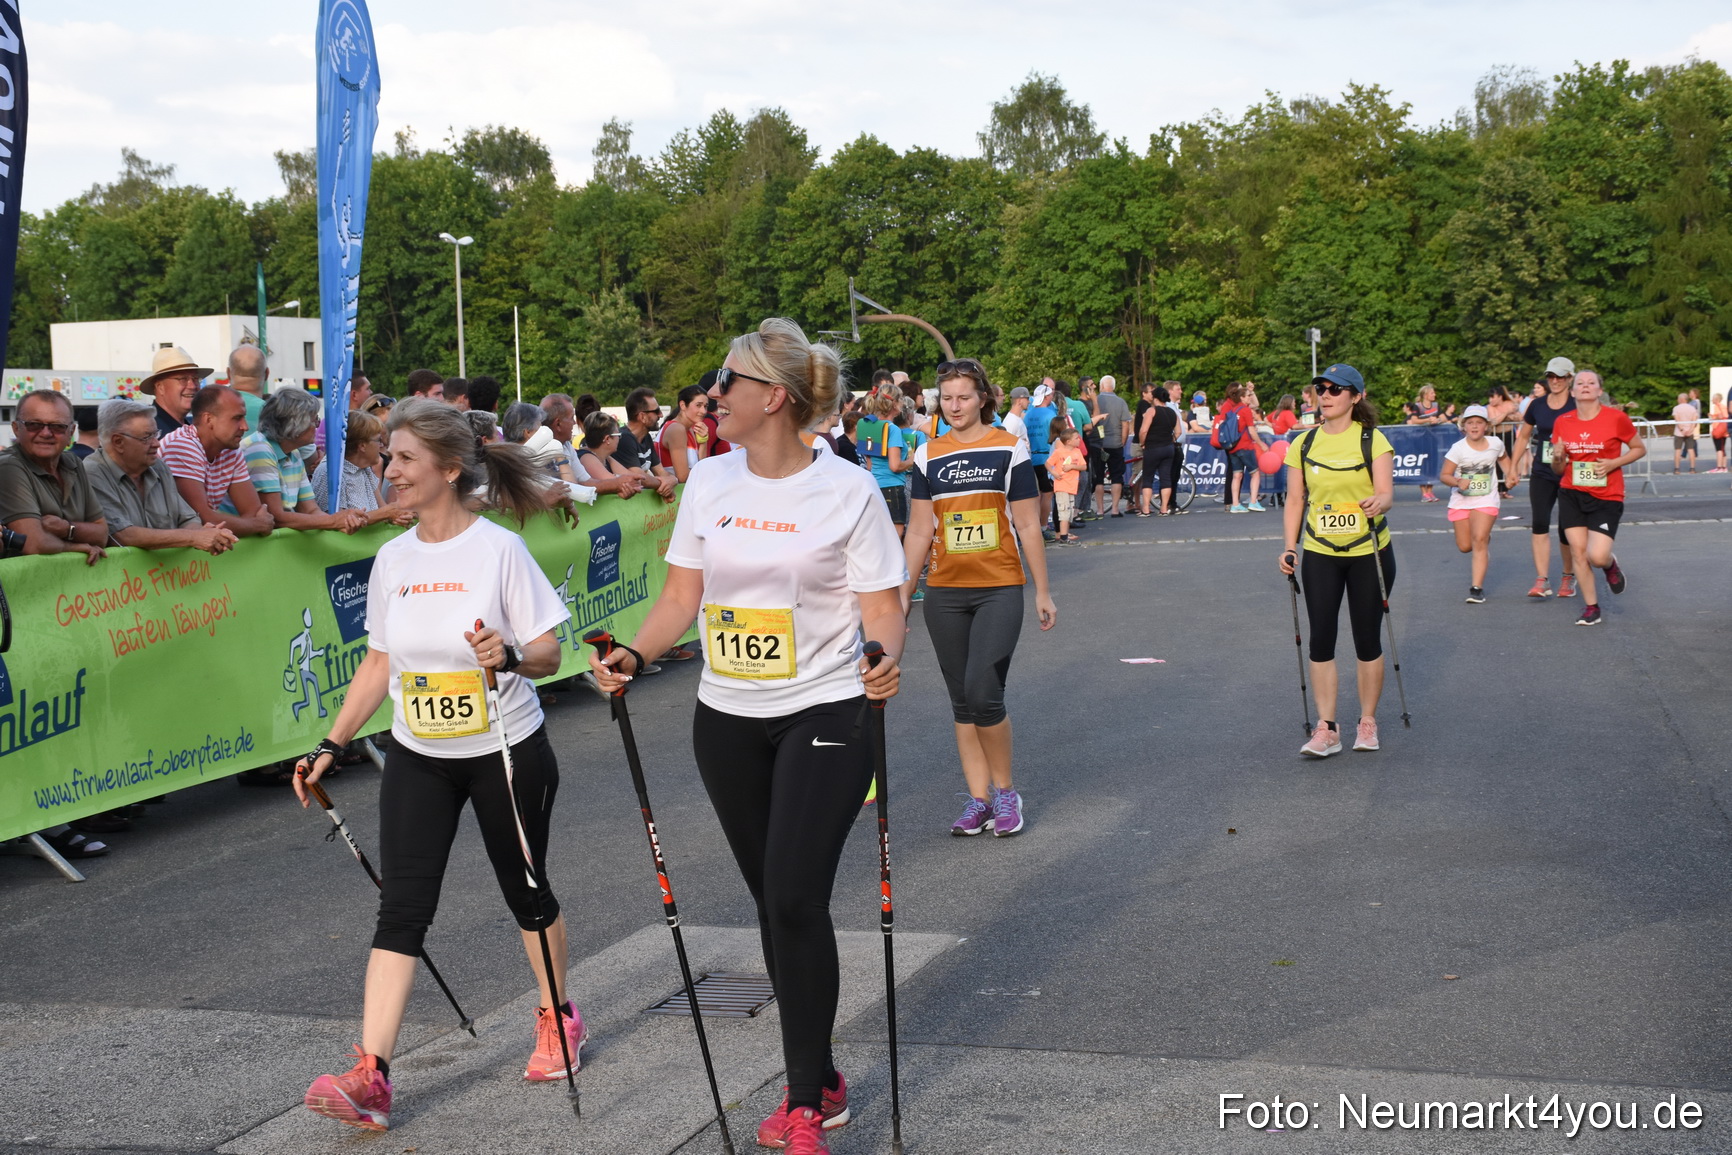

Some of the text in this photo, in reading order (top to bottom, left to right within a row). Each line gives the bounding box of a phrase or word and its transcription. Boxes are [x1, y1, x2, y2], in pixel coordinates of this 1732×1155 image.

[948, 466, 997, 480] Fischer
[953, 476, 993, 485] AUTOMOBILE
[1579, 471, 1599, 480] 585
[735, 517, 801, 533] KLEBL
[1320, 513, 1356, 528] 1200
[954, 525, 984, 541] 771
[595, 542, 617, 558] Fischer
[56, 560, 212, 627] Gesunde Firmen
[338, 582, 368, 602] Fische
[412, 583, 470, 594] KLEBL
[575, 562, 648, 629] firmenlauf
[108, 583, 237, 658] laufen länger!
[716, 631, 781, 660] 1162
[729, 659, 745, 667] Horn
[411, 695, 474, 719] 1185
[34, 726, 255, 810] www.firmenlauf-oberpfalz.de
[648, 822, 664, 862] LEKI
